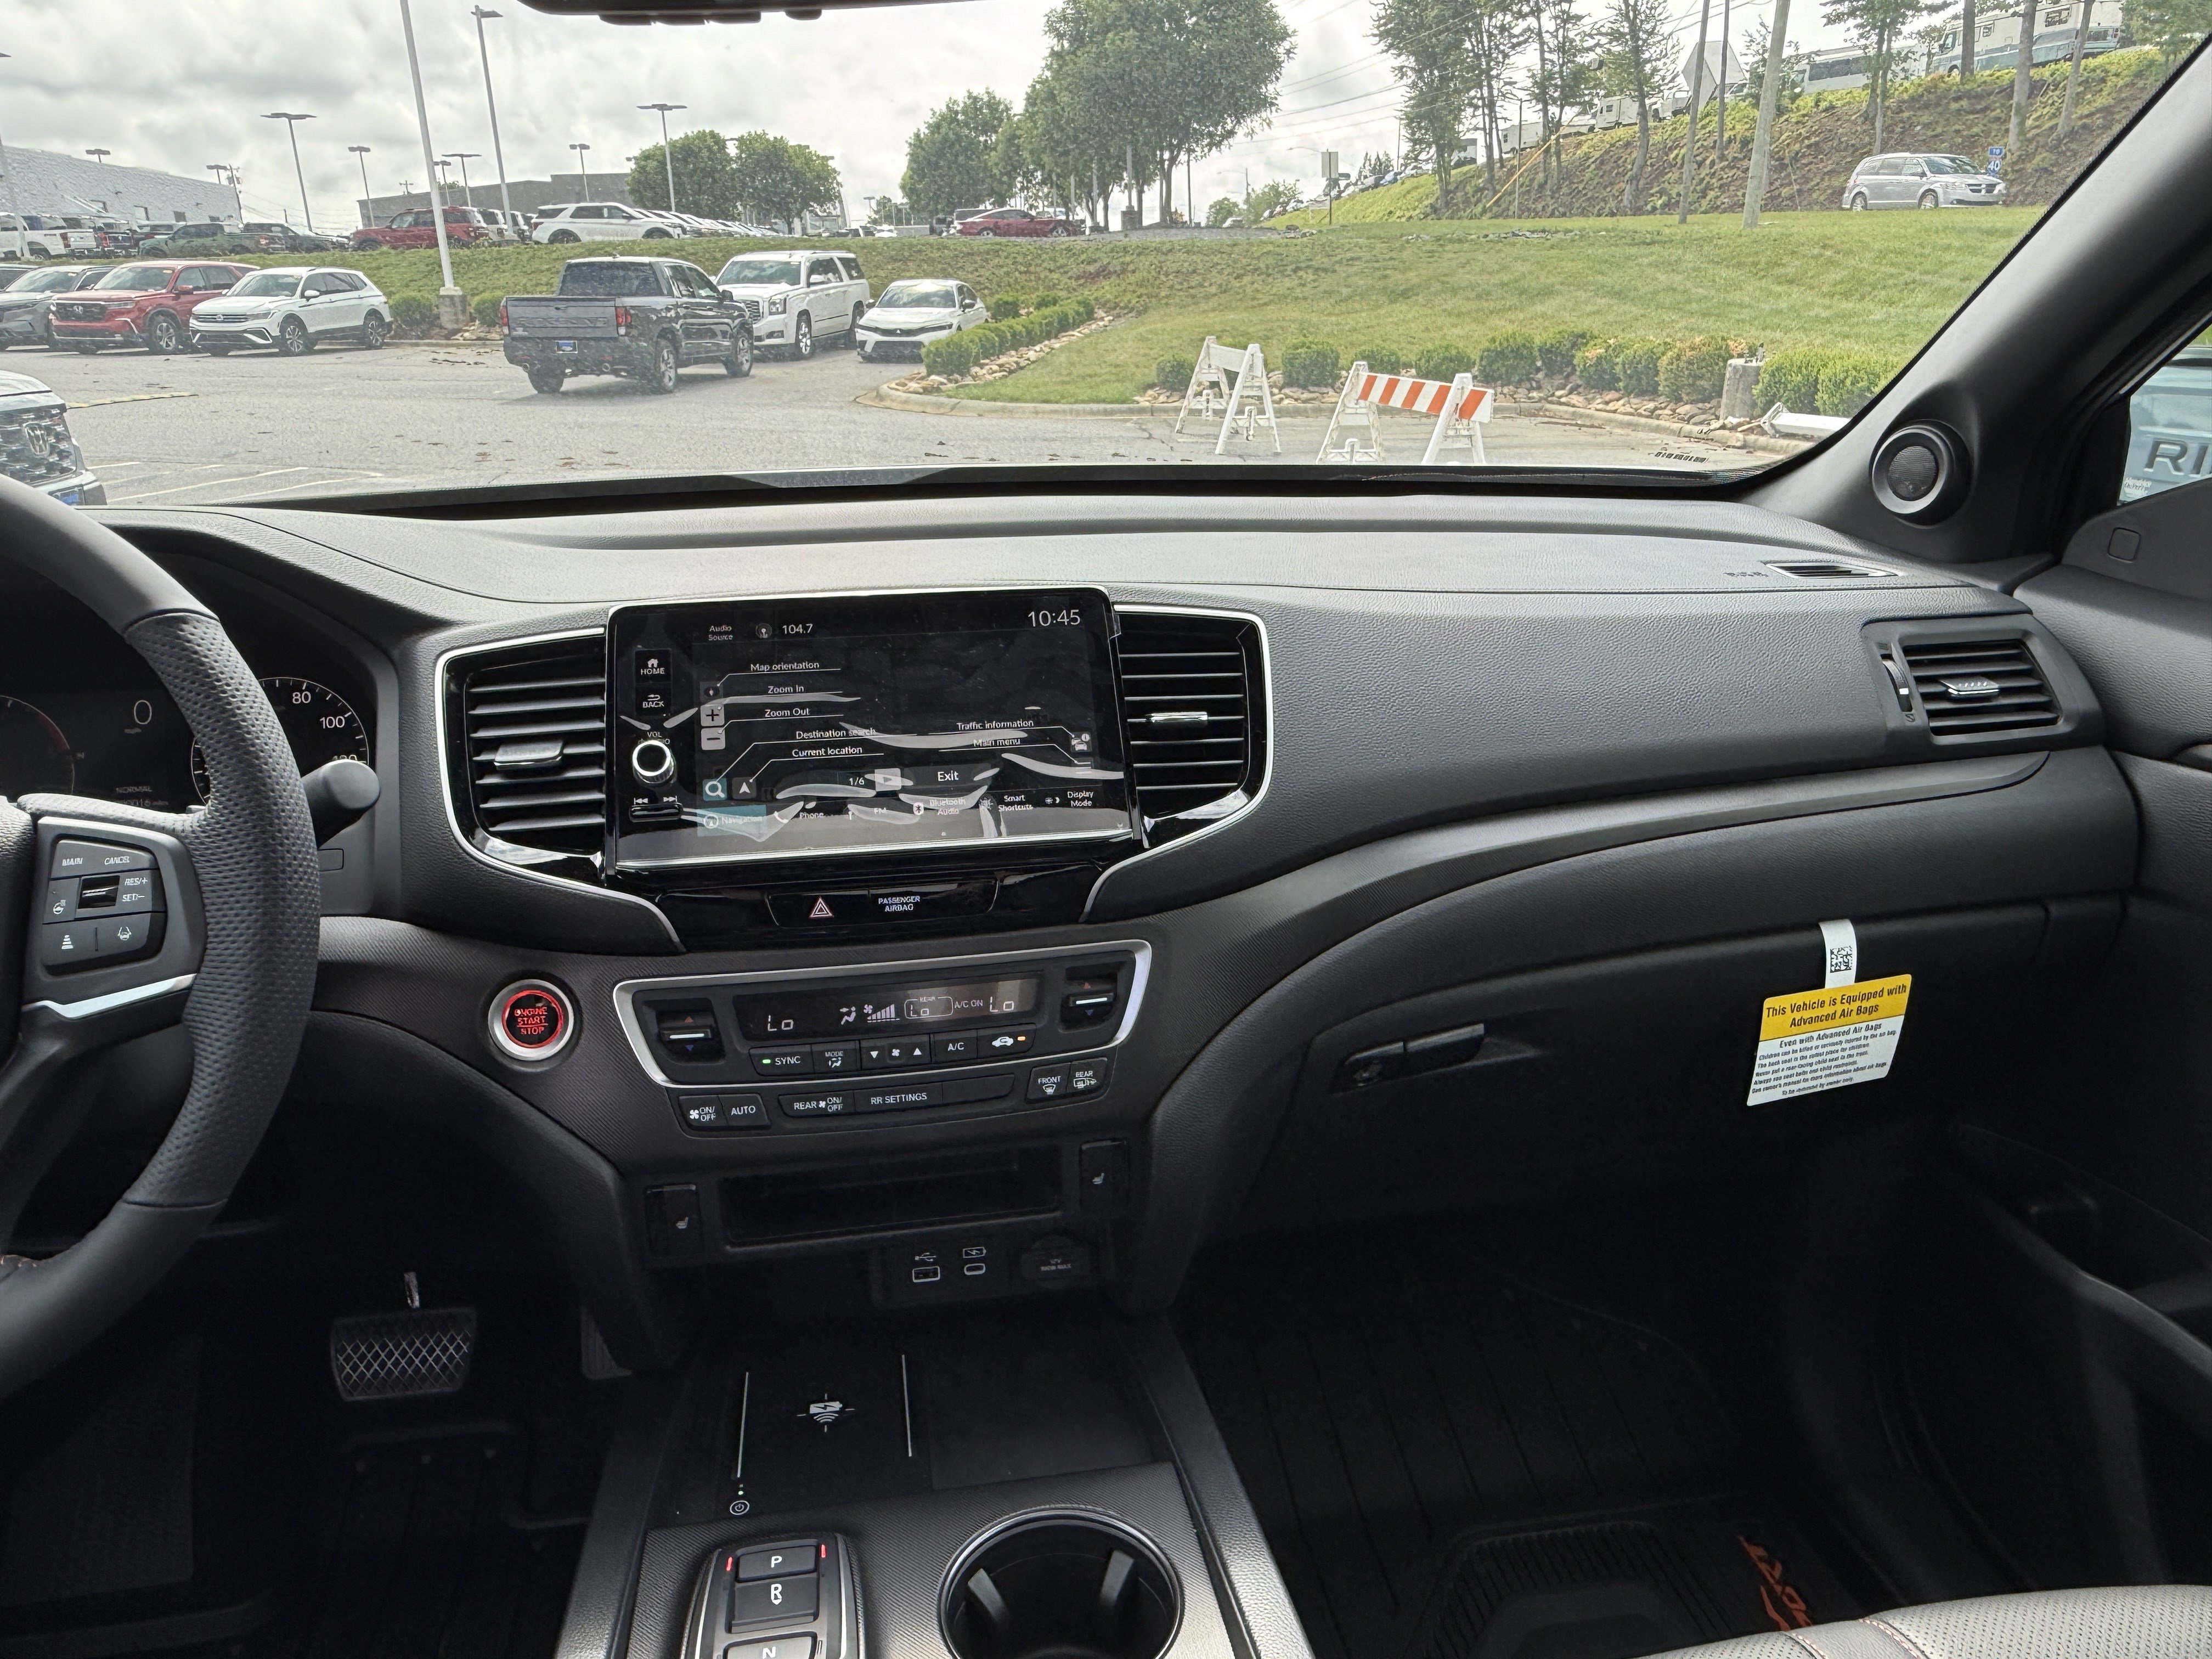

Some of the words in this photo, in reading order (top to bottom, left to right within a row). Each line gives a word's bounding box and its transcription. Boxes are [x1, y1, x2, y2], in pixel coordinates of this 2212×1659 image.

[1988, 160, 2000, 171] 40
[1028, 610, 1081, 627] 10:45
[782, 623, 814, 635] 104.7
[751, 663, 769, 674] Map
[772, 661, 820, 670] orientation
[768, 685, 793, 694] Zoom
[795, 685, 804, 693] In
[292, 691, 312, 704] 80
[134, 699, 152, 725] 0
[764, 709, 791, 718] Zoom
[793, 708, 810, 716] Out
[320, 716, 345, 729] 100
[956, 721, 983, 730] Traffic
[985, 719, 1034, 729] information
[796, 729, 846, 740] Destination
[848, 727, 876, 736] search
[792, 748, 825, 757] Current
[827, 746, 862, 755] location
[938, 770, 959, 781] Exit
[849, 777, 865, 785] 1/6
[1068, 791, 1093, 799] Display
[930, 799, 967, 807] Bluetooth
[62, 858, 83, 866] MAIN
[104, 856, 130, 865] CANCEL
[878, 895, 921, 904] PASSENGER
[885, 904, 913, 912] AIRBAG
[954, 1001, 969, 1009] A/C
[1766, 1006, 1786, 1018] This
[1790, 998, 1825, 1014] Vehicle
[1829, 996, 1837, 1006] is
[1840, 987, 1884, 1005] Equipped
[1887, 984, 1907, 996] with
[514, 1006, 548, 1017] ENGINE
[1790, 1010, 1837, 1028] Advanced
[1838, 1007, 1854, 1019] Air
[1856, 1003, 1880, 1016] Bags
[517, 1016, 546, 1025] START
[521, 1026, 545, 1035] STOP
[1779, 1039, 1797, 1048] Even
[1799, 1035, 1814, 1044] with
[1816, 1028, 1850, 1041] Advanced
[947, 1042, 964, 1051] A/C
[775, 1056, 801, 1065] SYNC
[1038, 1076, 1061, 1084] FRONT
[871, 1097, 883, 1105] RR
[884, 1092, 927, 1104] SETTINGS
[731, 1105, 756, 1115] AUTO
[794, 1101, 817, 1110] REAR
[827, 1103, 843, 1112] OFF
[700, 1113, 716, 1121] OFF
[771, 1555, 782, 1568] P
[771, 1583, 782, 1600] R
[763, 1646, 776, 1659] N
